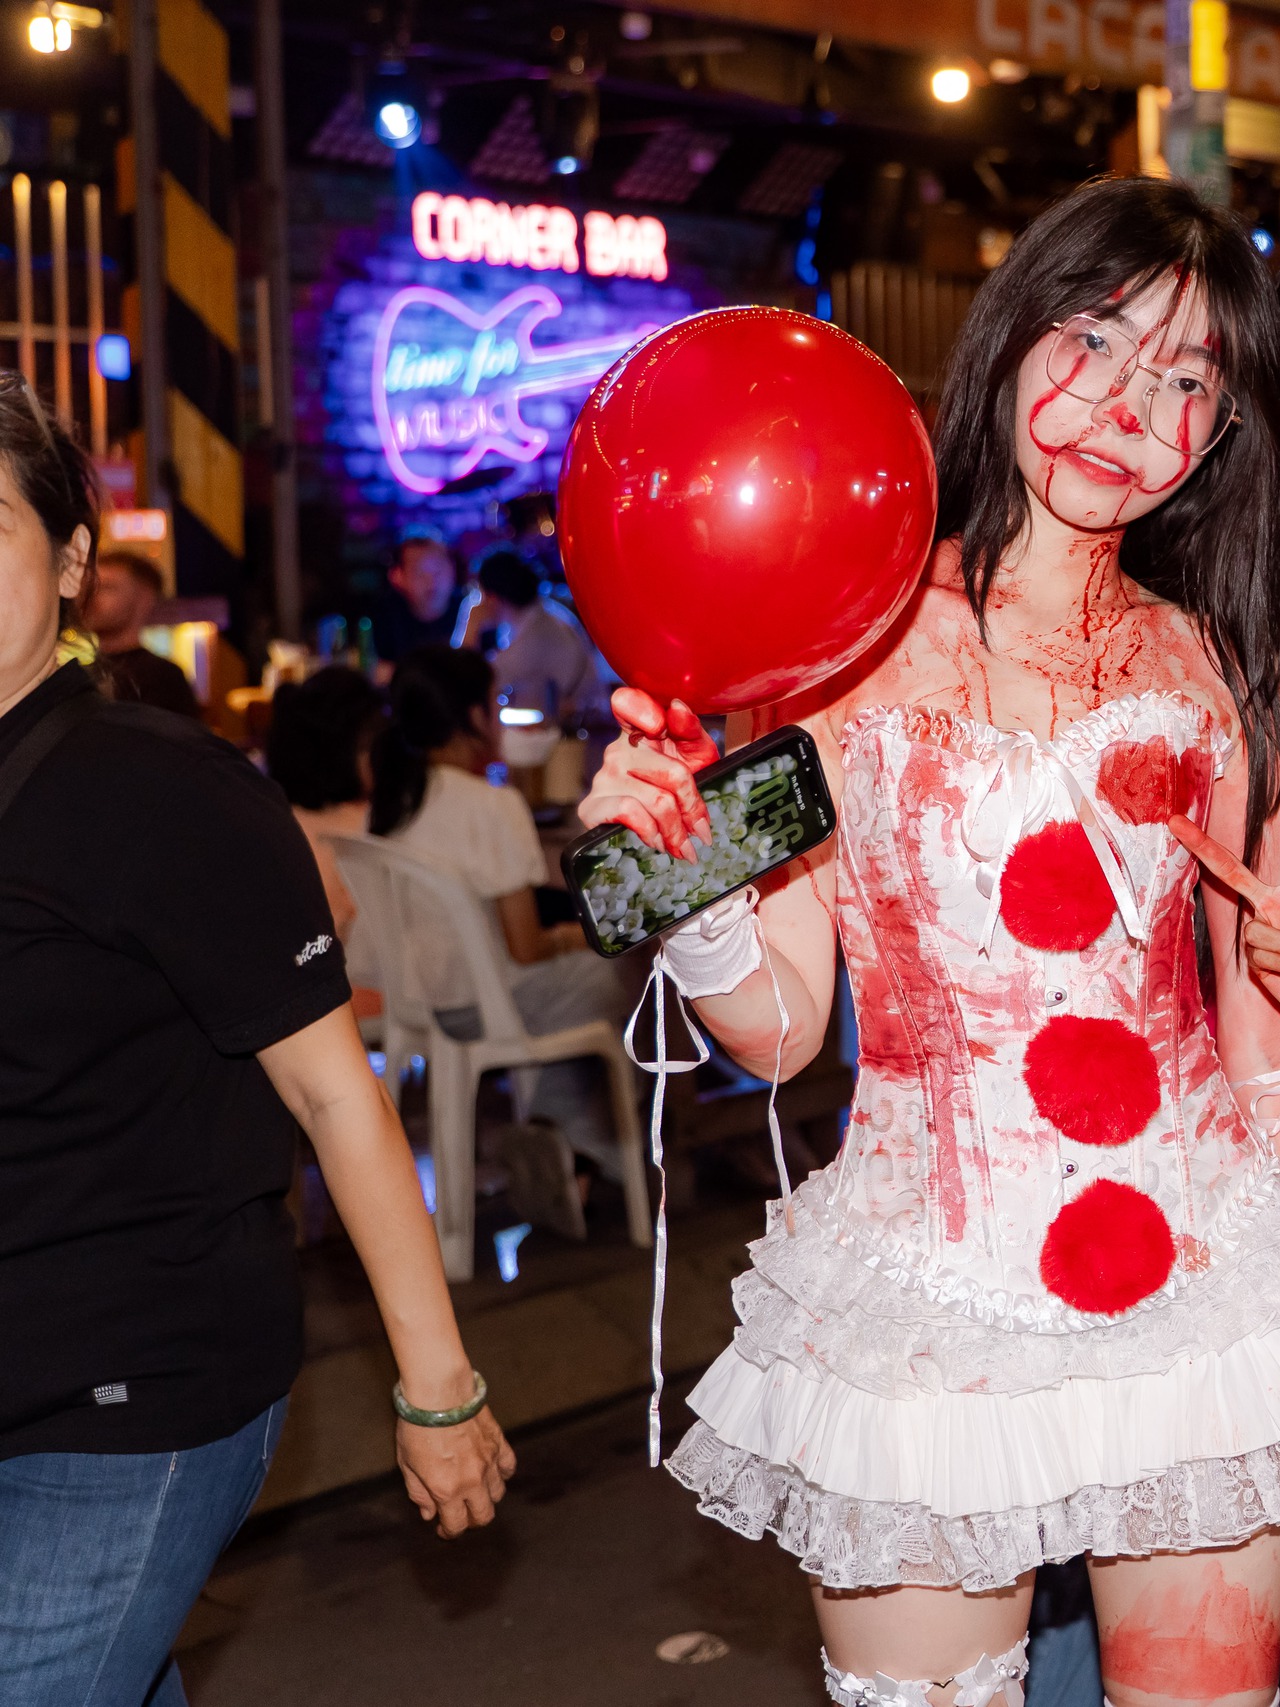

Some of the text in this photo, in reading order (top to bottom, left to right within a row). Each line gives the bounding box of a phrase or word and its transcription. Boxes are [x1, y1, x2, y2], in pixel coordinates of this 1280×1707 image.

[412, 191, 668, 281] CORNER BAR
[385, 330, 519, 396] time for
[397, 398, 511, 451] MUSIC
